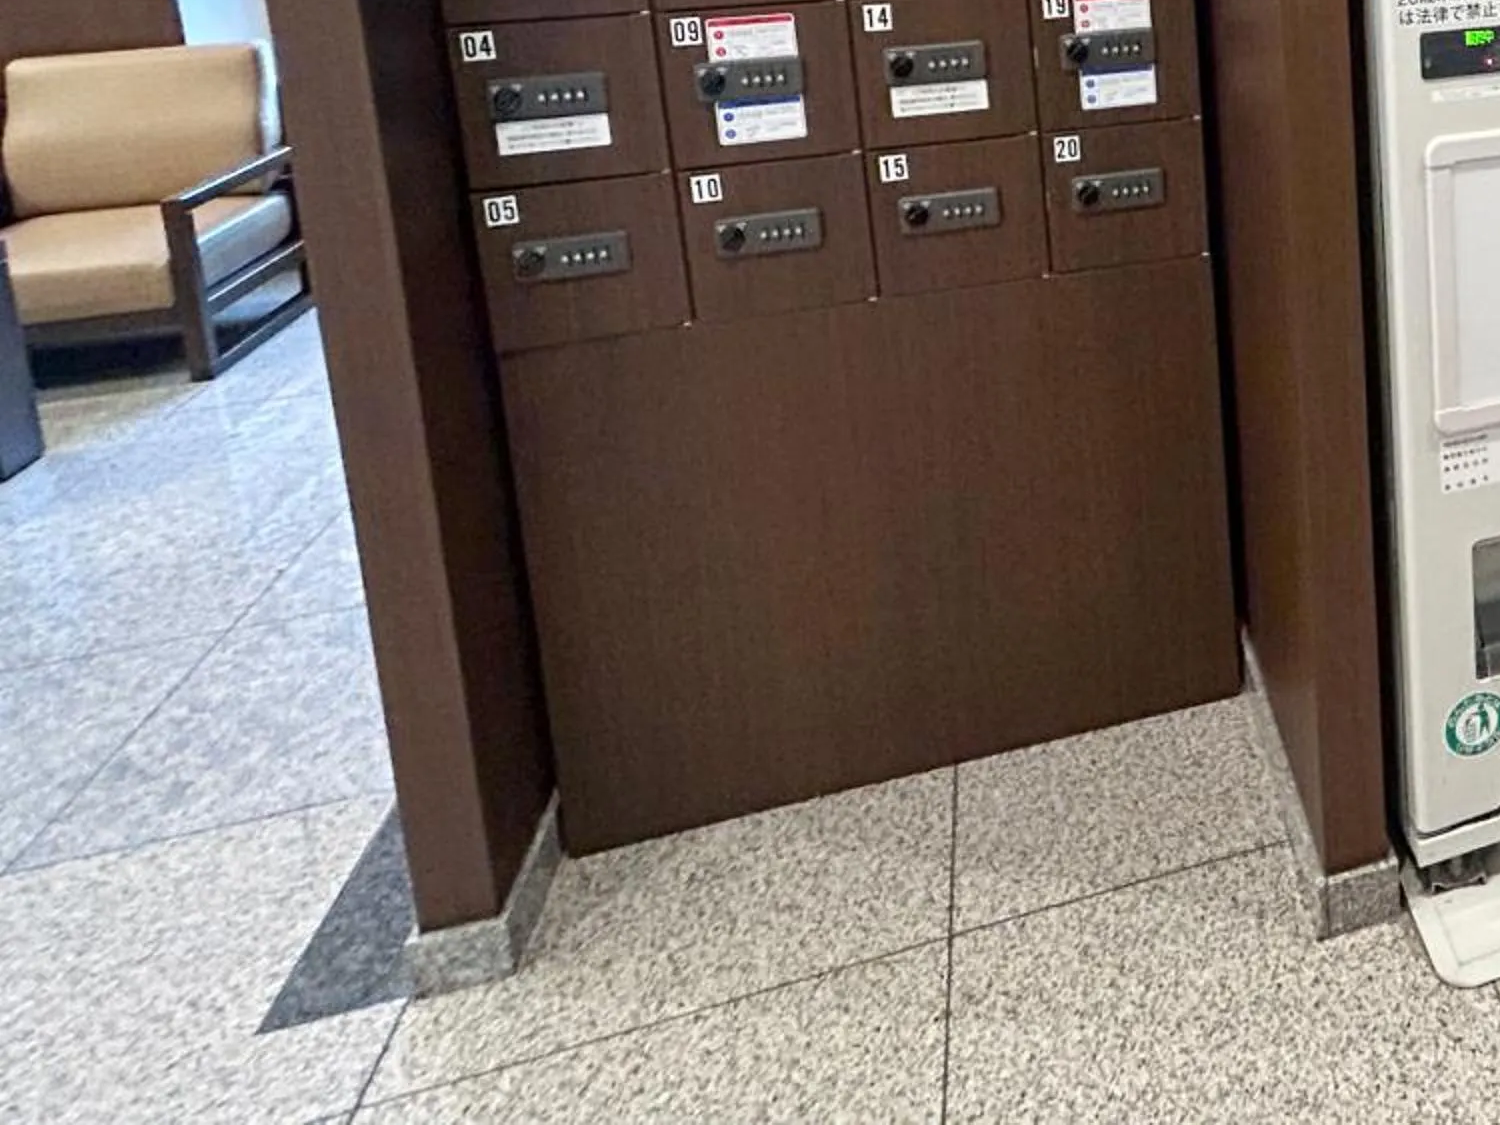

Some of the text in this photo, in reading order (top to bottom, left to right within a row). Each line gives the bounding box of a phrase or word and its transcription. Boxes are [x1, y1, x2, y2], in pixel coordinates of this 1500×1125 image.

[866, 7, 889, 28] 14
[673, 20, 699, 42] 09
[463, 34, 492, 58] 04
[1056, 138, 1078, 159] 20
[883, 157, 905, 178] 15
[695, 178, 719, 199] 10
[487, 199, 515, 223] 05
